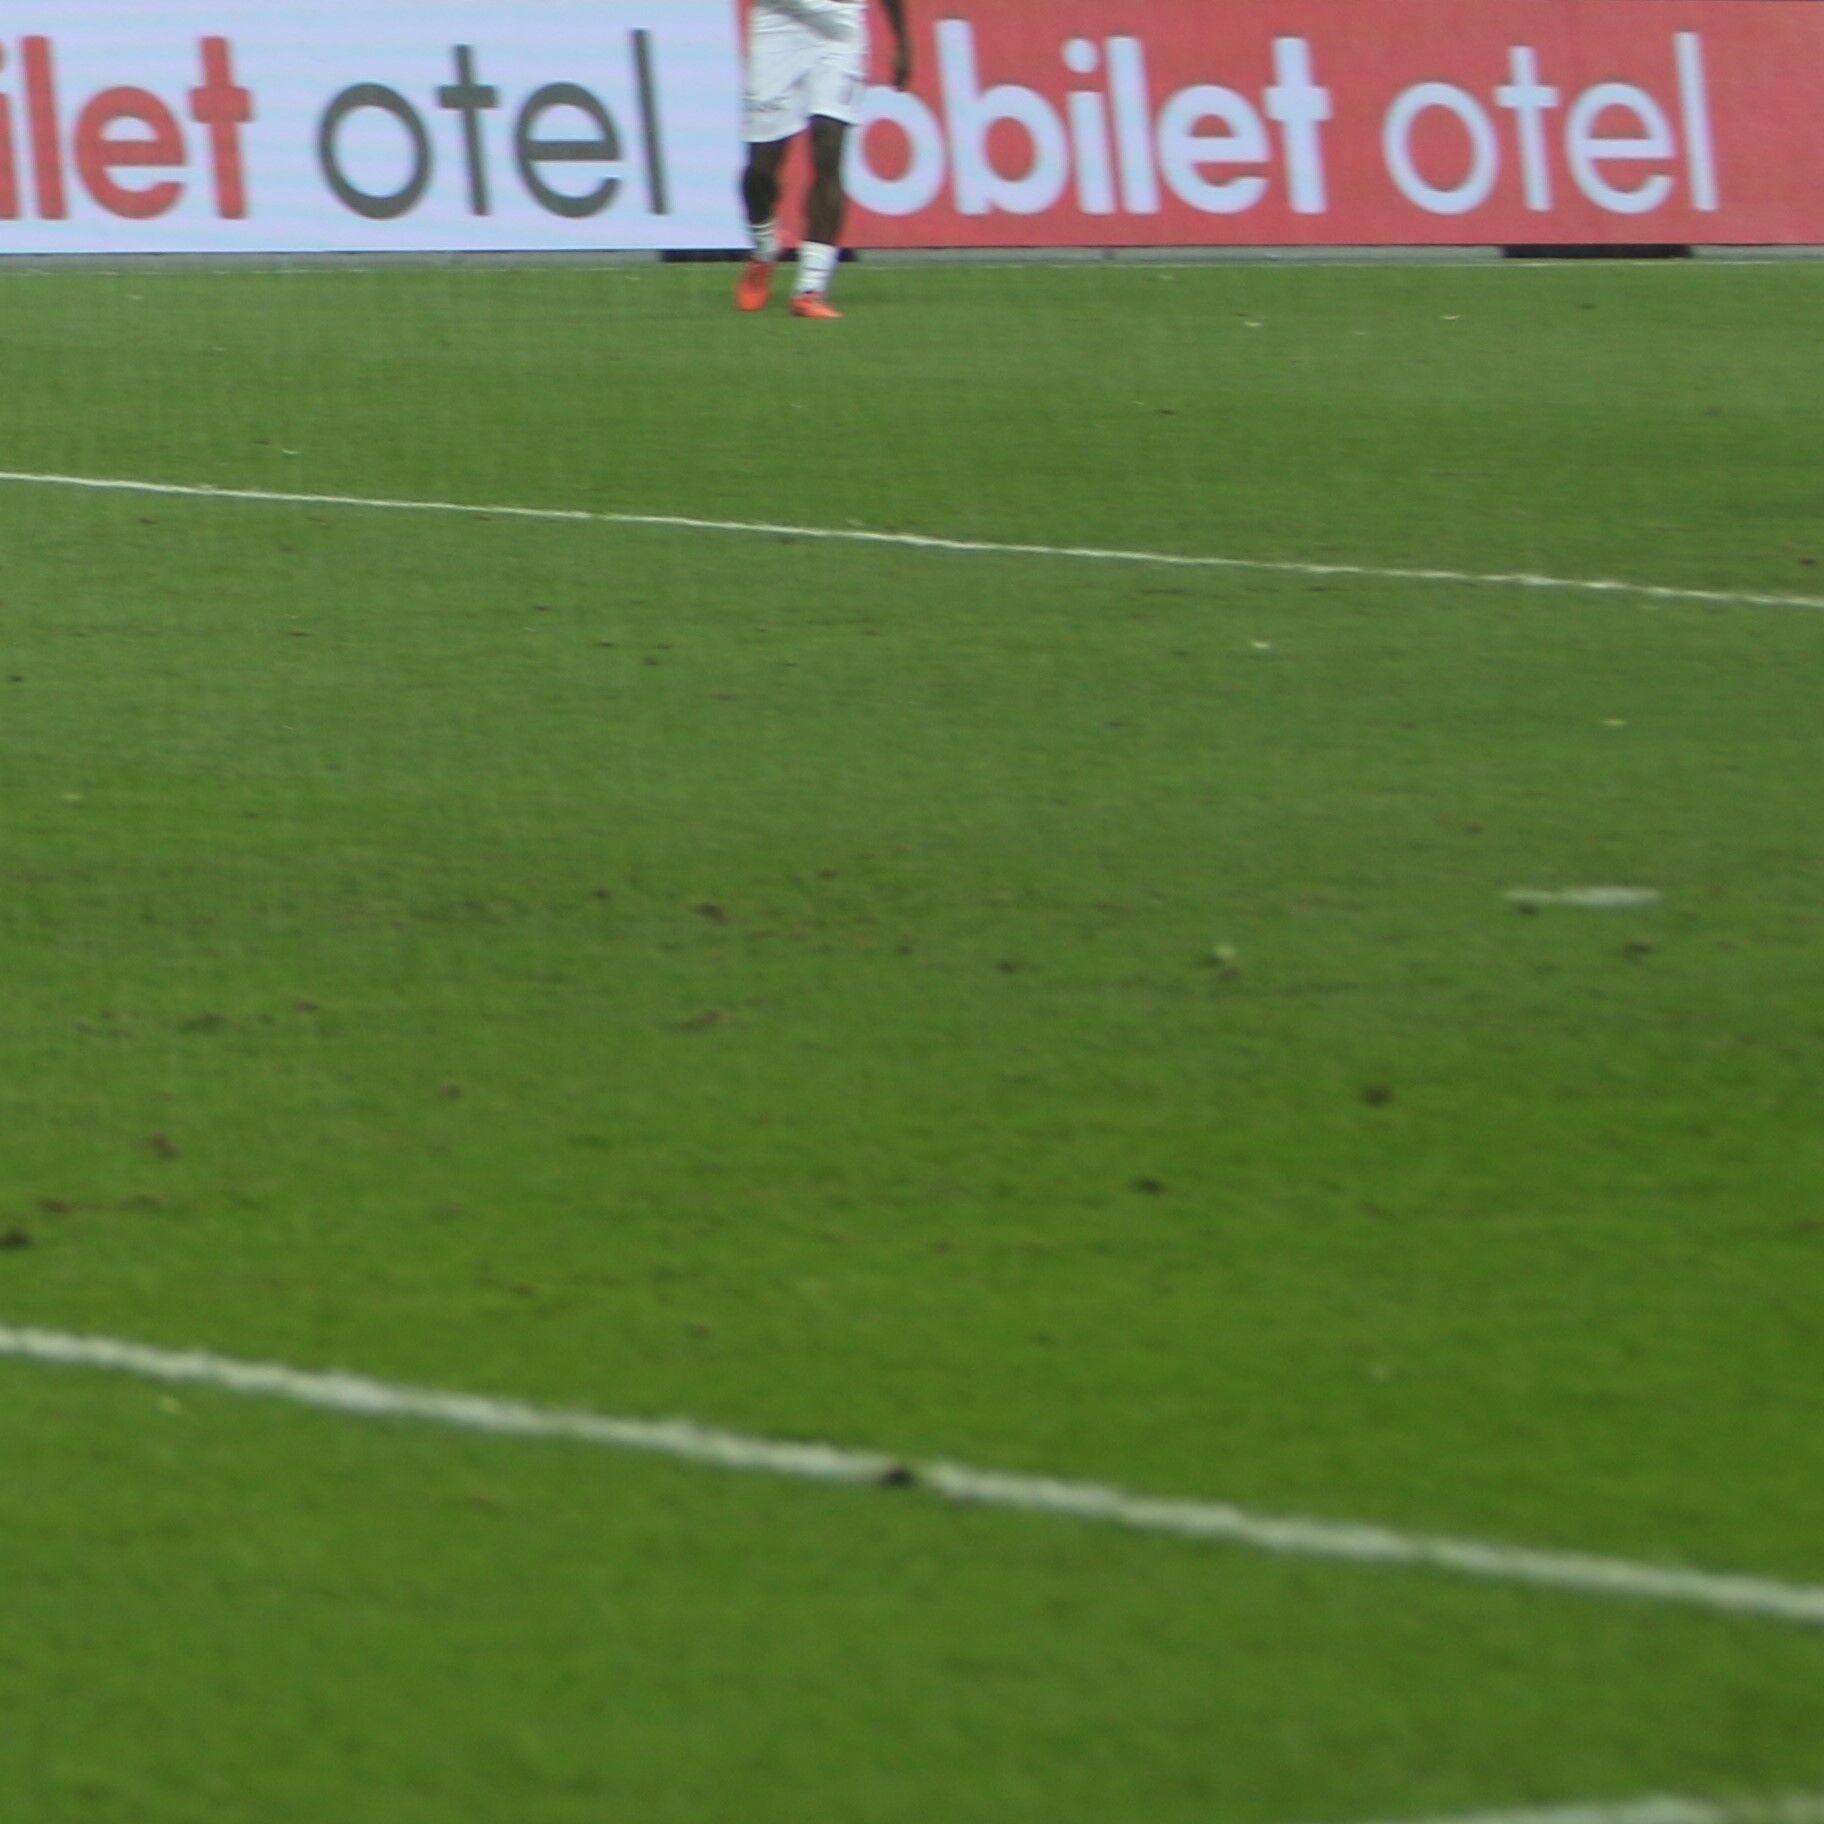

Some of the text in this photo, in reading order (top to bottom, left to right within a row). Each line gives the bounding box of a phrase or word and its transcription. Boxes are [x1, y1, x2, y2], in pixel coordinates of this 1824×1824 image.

[317, 30, 670, 220] otel
[844, 18, 1718, 215] obilet otel
